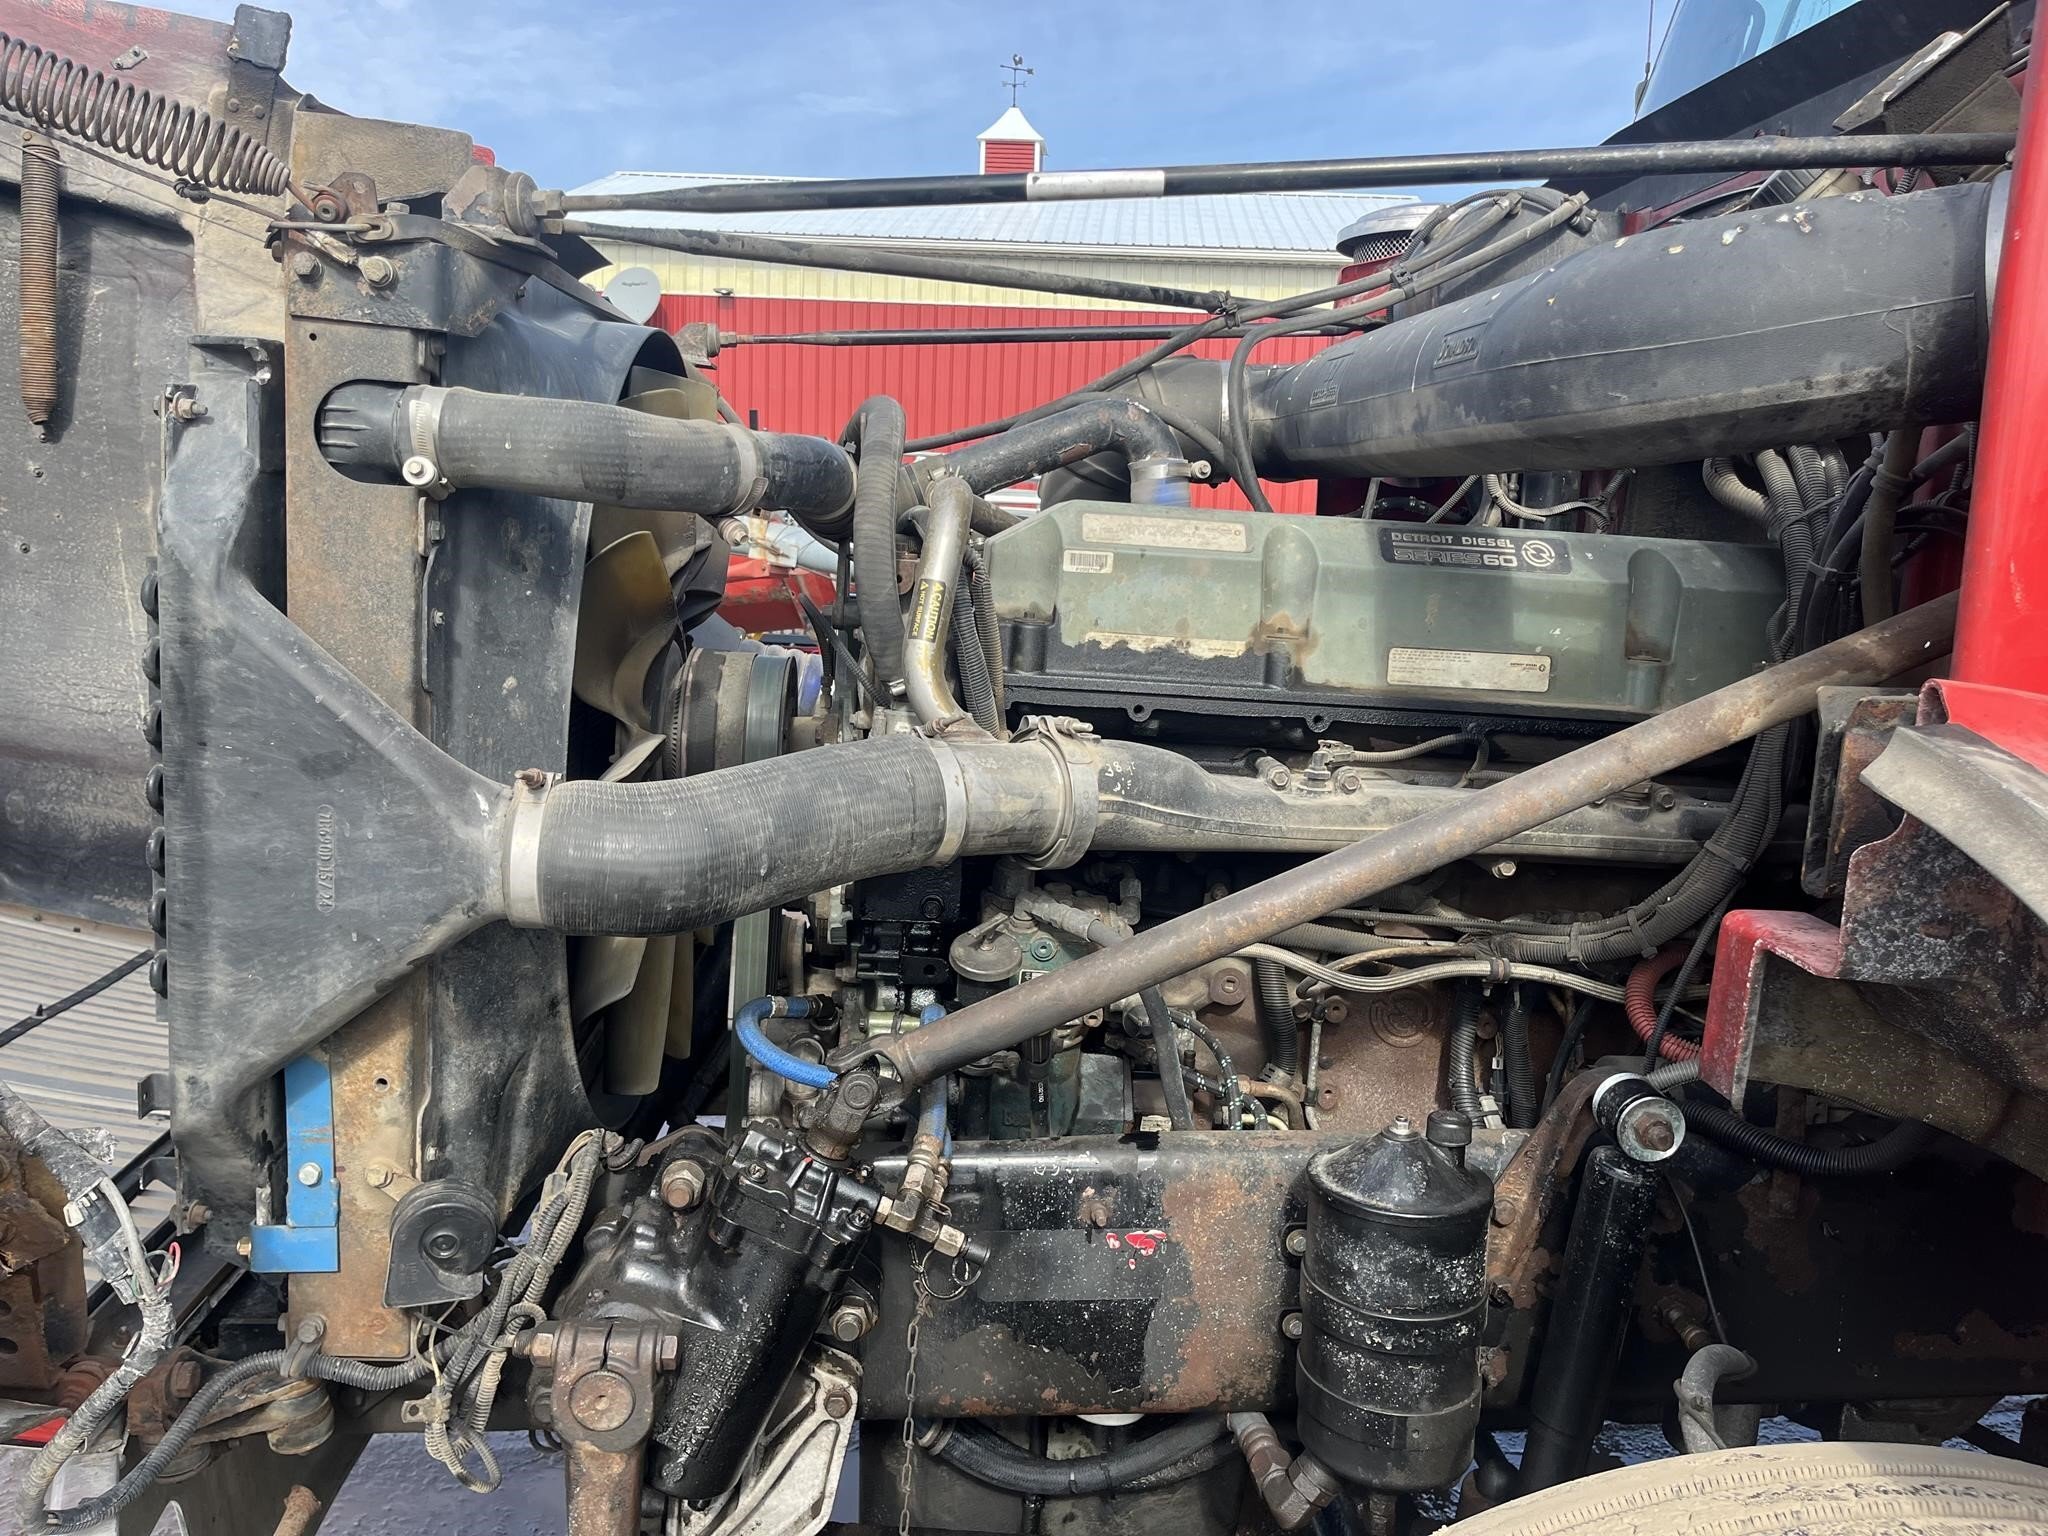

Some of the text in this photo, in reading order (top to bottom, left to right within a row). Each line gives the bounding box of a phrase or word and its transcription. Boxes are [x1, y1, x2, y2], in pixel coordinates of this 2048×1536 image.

[1391, 532, 1515, 549] DETROIT DIESEL
[1393, 548, 1518, 568] SERIES 60
[912, 605, 922, 637] SURFACE
[925, 593, 941, 639] CAUTION
